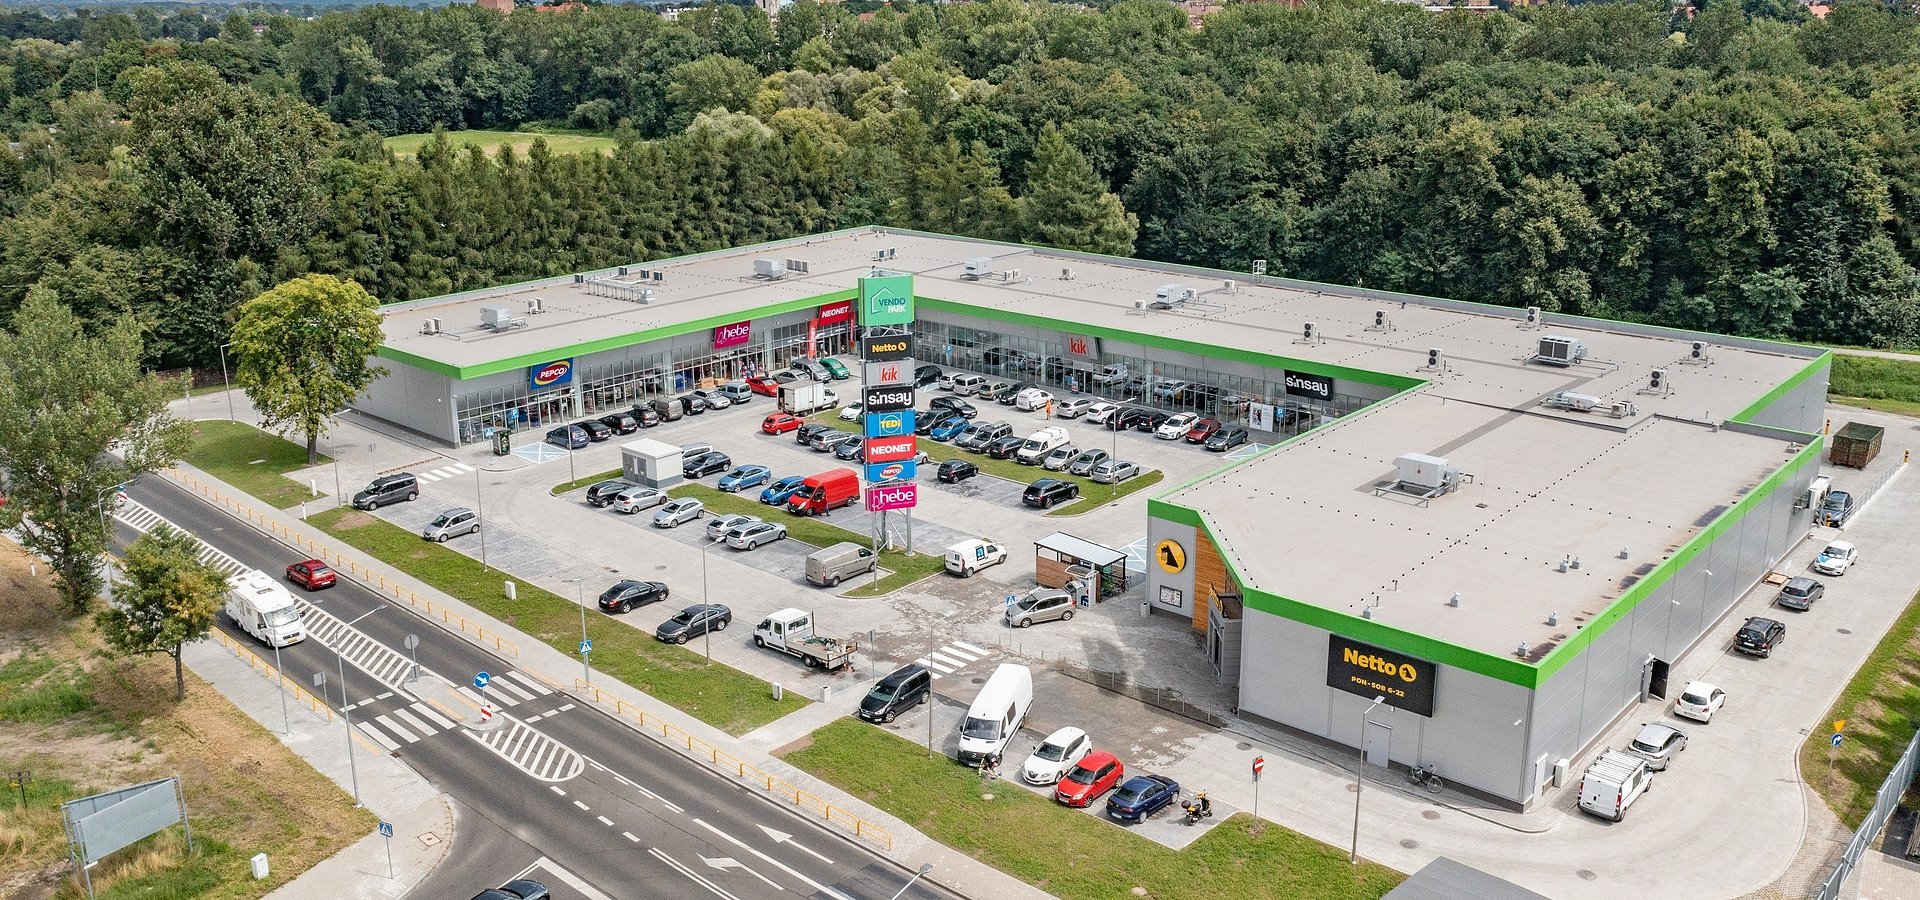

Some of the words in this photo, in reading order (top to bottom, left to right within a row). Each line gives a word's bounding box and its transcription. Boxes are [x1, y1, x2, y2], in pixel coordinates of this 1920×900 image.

[878, 297, 906, 306] VENDO
[888, 304, 906, 313] PARK
[821, 306, 850, 319] NEONET
[723, 324, 749, 339] hebe
[872, 343, 897, 353] Netto
[1069, 336, 1087, 355] kik
[540, 367, 565, 379] PEPCO
[881, 365, 898, 382] kik
[1285, 374, 1329, 396] sinsay
[868, 391, 912, 406] sinsay
[871, 443, 912, 455] NEONET
[880, 488, 914, 504] hebe
[1343, 647, 1397, 676] Netto
[1387, 687, 1405, 698] 6-22
